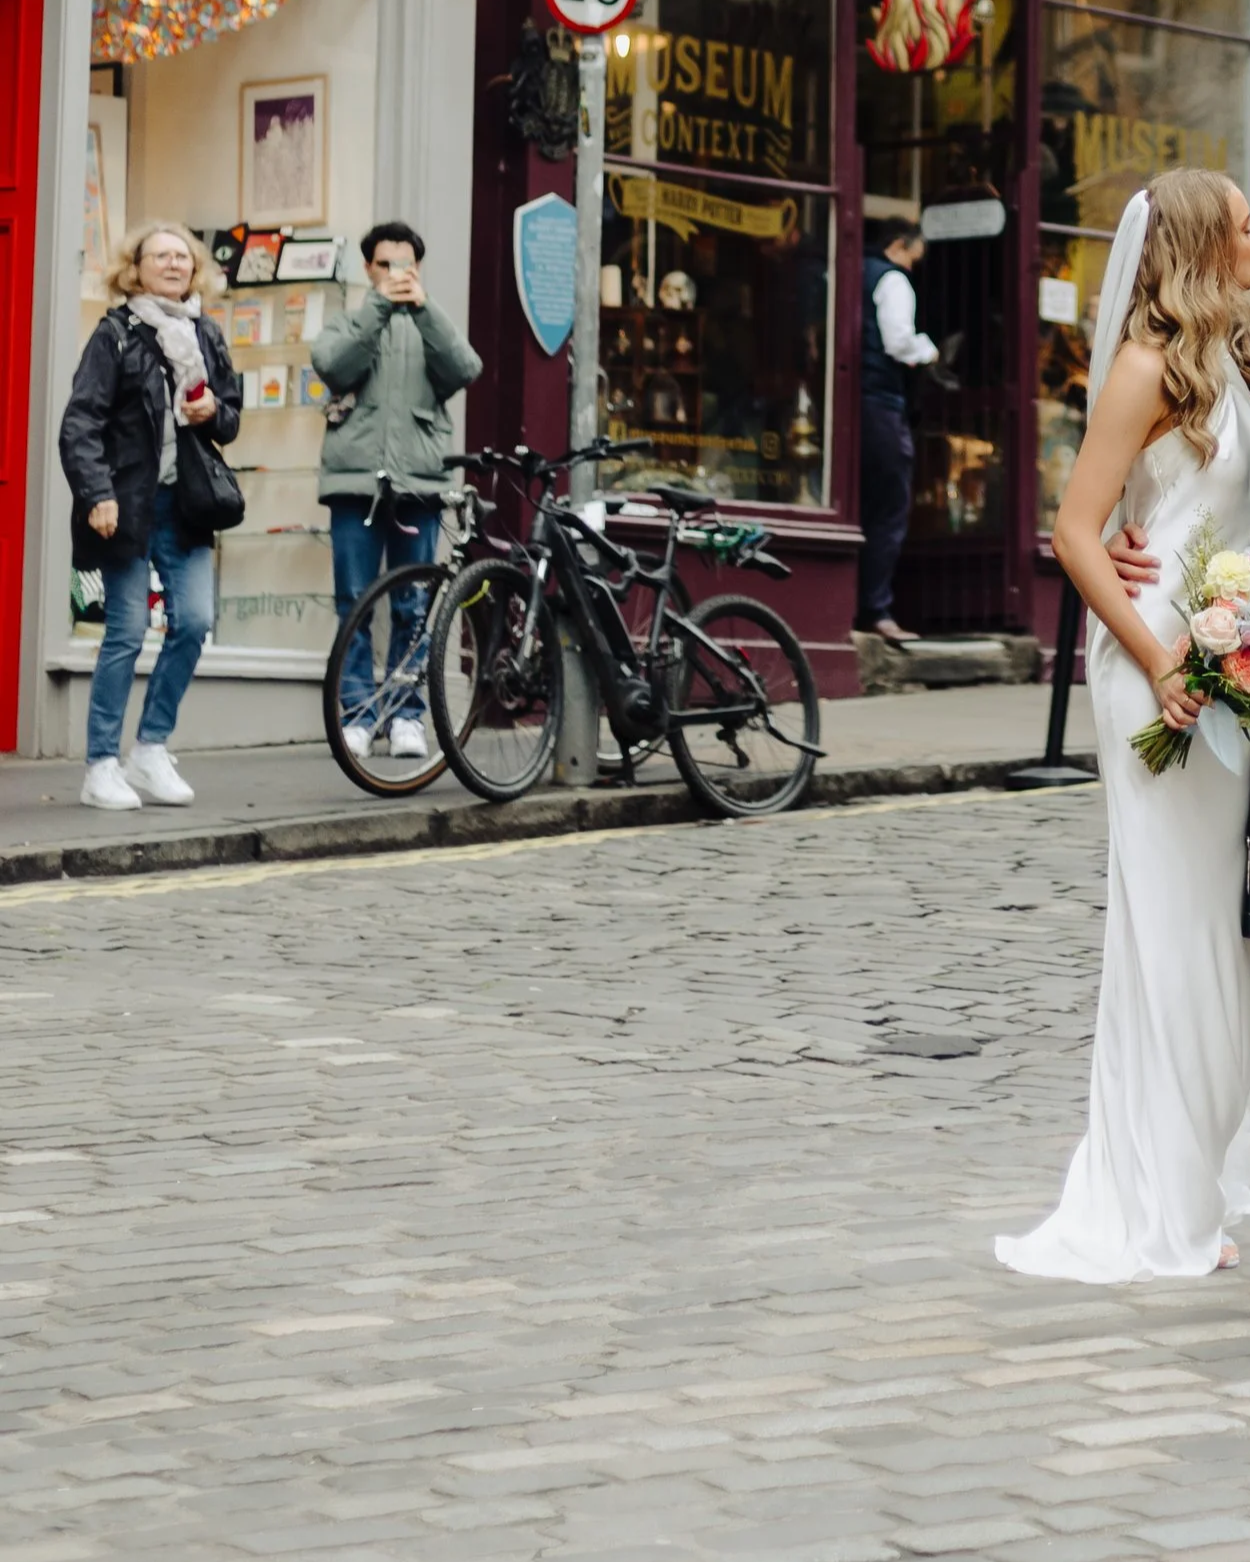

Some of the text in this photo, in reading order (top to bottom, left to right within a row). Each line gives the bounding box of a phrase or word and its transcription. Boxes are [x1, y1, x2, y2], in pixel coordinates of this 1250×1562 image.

[605, 31, 794, 130] MUSEUM
[641, 107, 757, 162] CONTEXT
[236, 591, 306, 623] gallery
